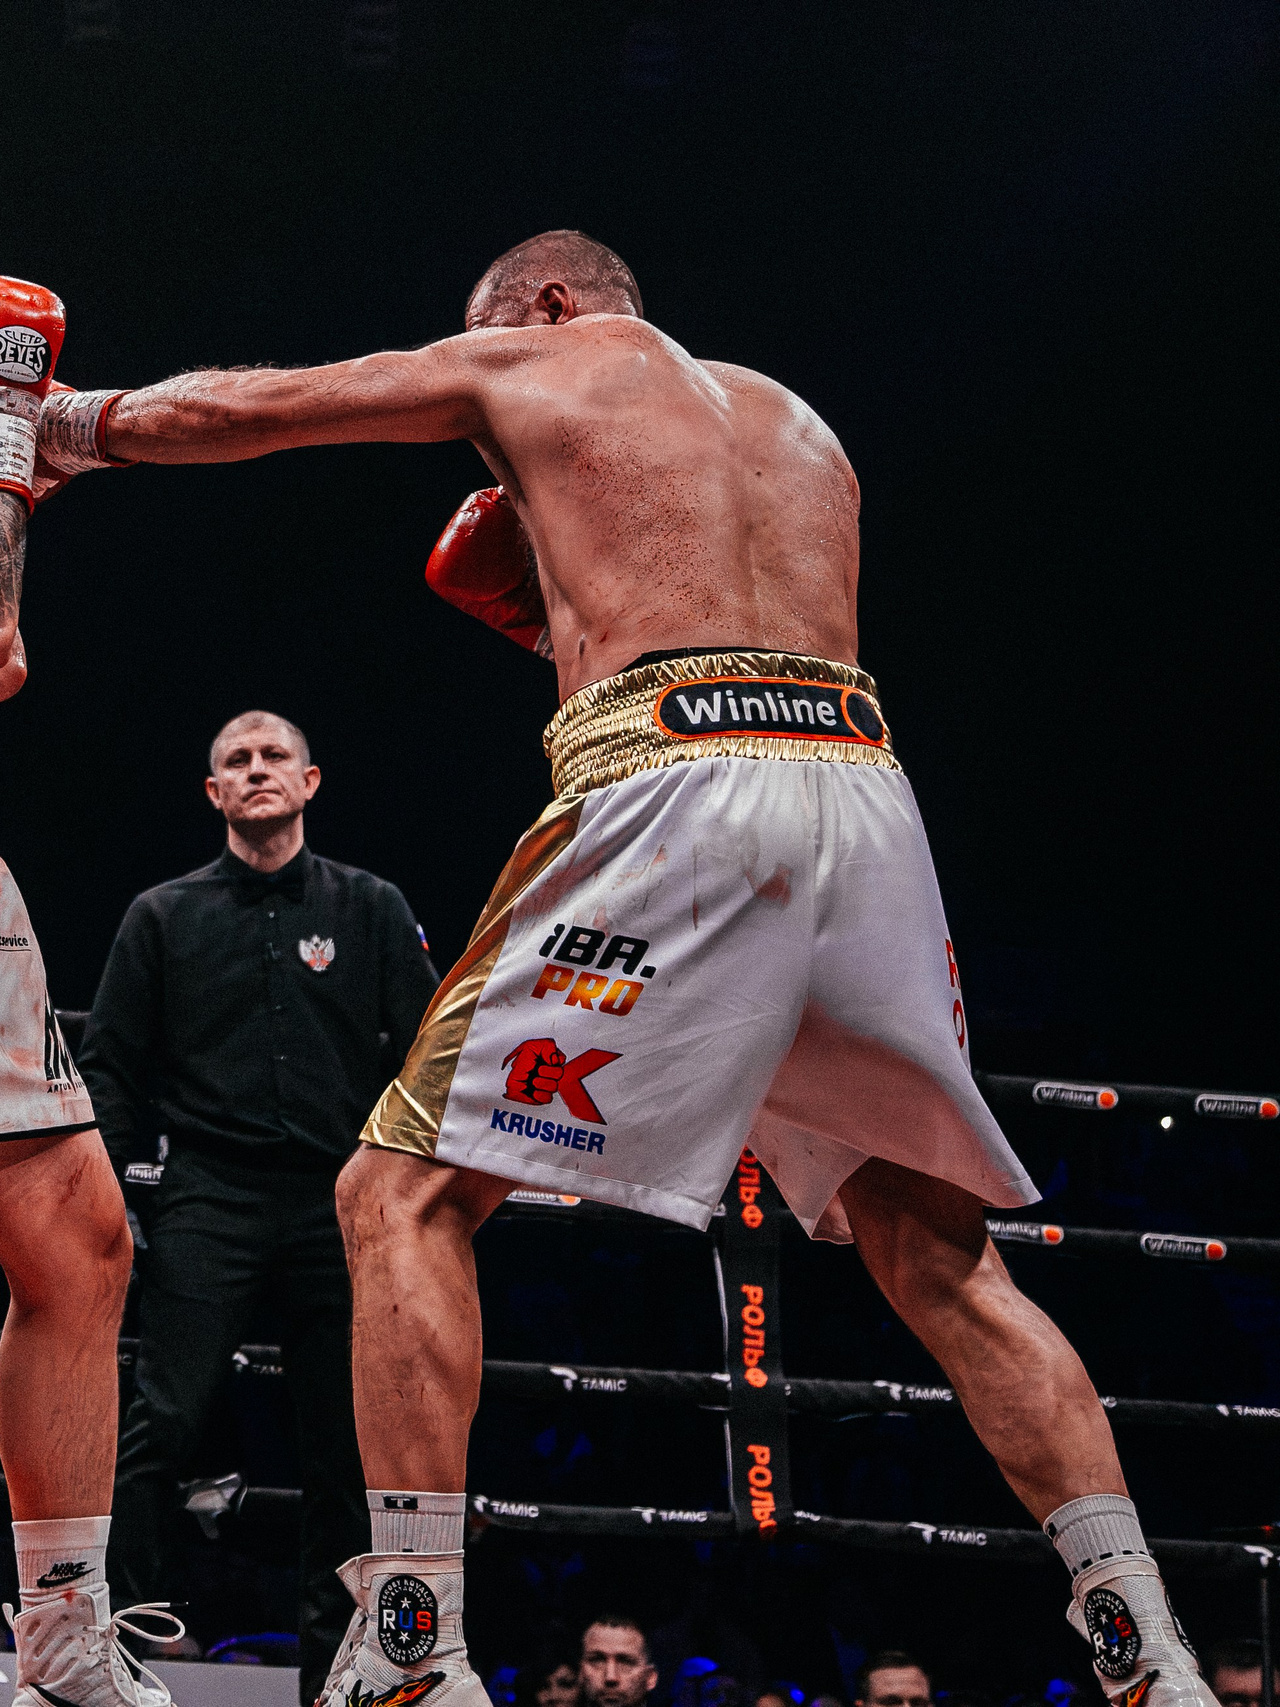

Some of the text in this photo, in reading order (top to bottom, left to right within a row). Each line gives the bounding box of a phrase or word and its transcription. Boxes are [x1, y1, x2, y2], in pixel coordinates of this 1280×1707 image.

[5, 329, 43, 344] CLETO
[676, 690, 837, 726] Winline
[530, 963, 645, 1017] PRO
[1041, 1087, 1095, 1105] Winline
[1202, 1099, 1257, 1114] Winline
[490, 1108, 606, 1155] KRUSHER
[1148, 1238, 1203, 1254] Winline
[741, 1284, 768, 1388] РОЛЬФ
[580, 1378, 627, 1392] TAMIC
[905, 1386, 953, 1401] TAMIC
[490, 1500, 539, 1518] TAMIC
[658, 1510, 708, 1523] TAMIC
[938, 1529, 988, 1546] TAMIC
[46, 1561, 87, 1578] NIKE
[383, 1609, 432, 1631] RUS
[1093, 1616, 1132, 1654] RUS
